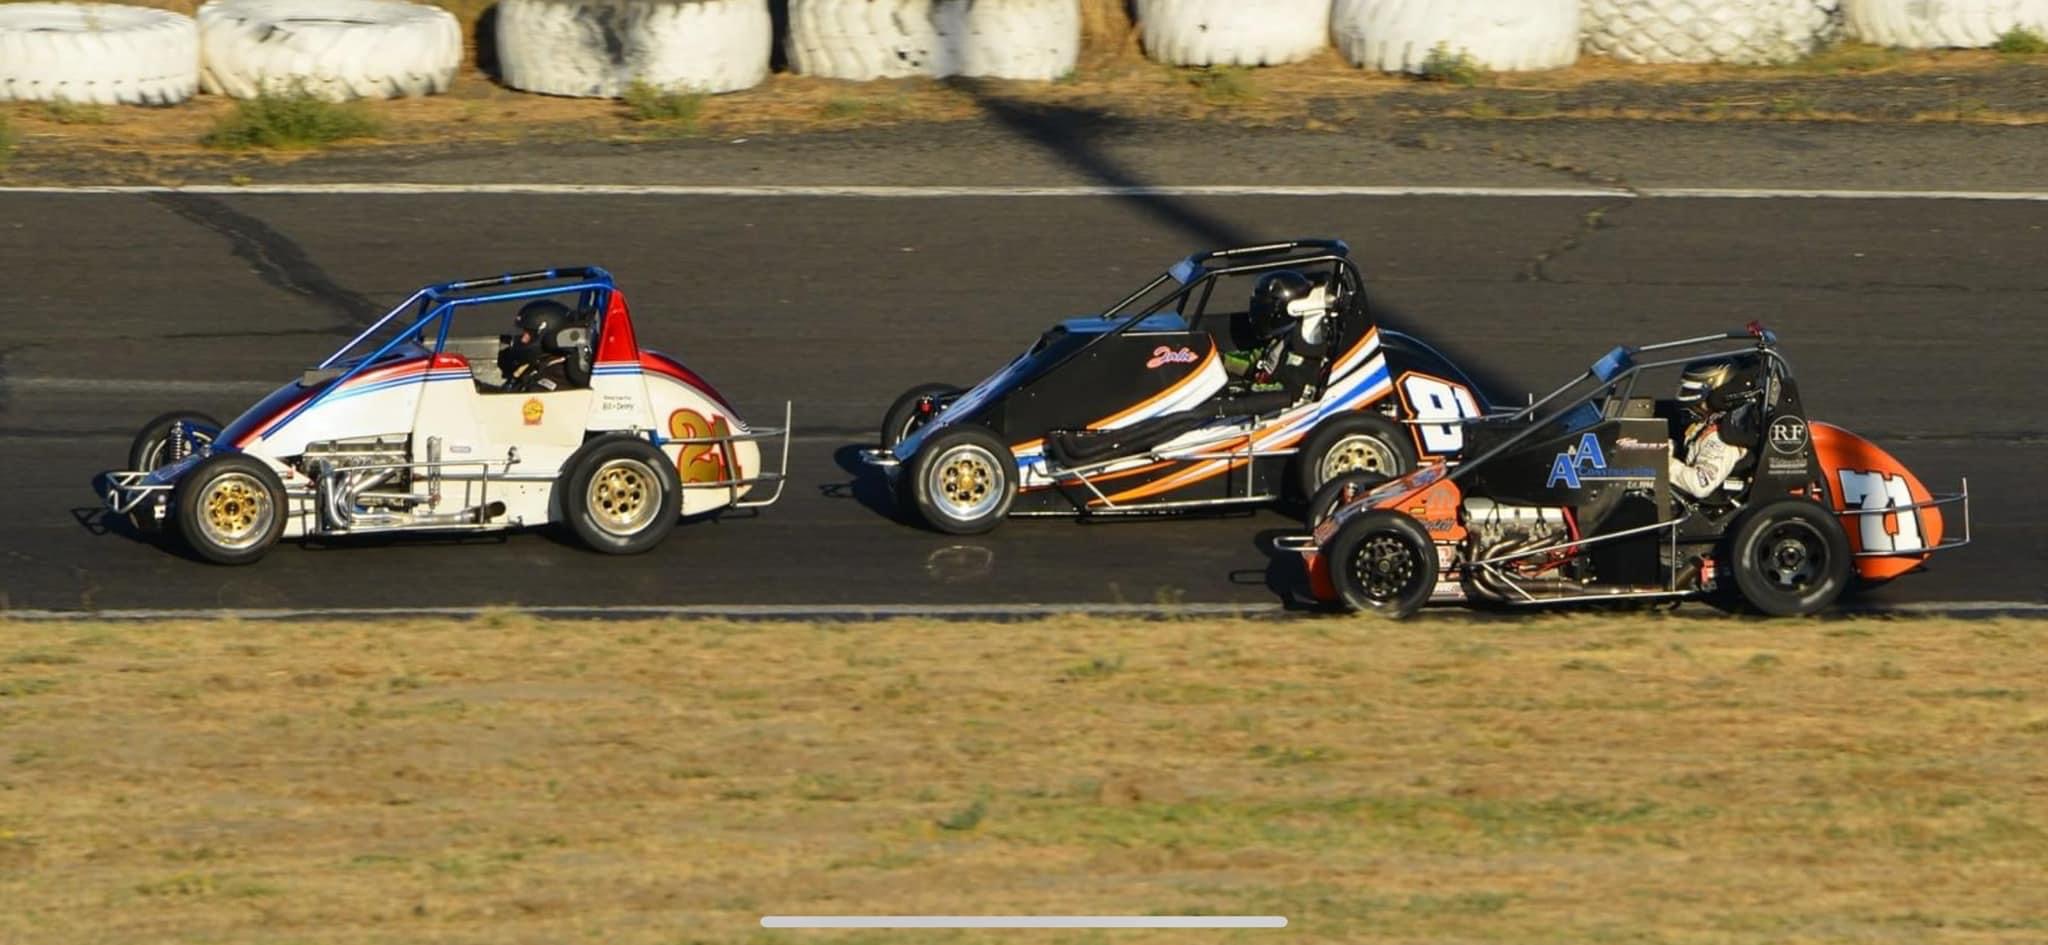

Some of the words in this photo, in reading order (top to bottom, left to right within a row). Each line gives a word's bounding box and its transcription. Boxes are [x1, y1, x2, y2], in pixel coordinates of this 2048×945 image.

[668, 408, 743, 486] 21
[1546, 453, 1581, 488] A
[1573, 432, 1607, 468] A
[1837, 469, 1923, 553] 71
